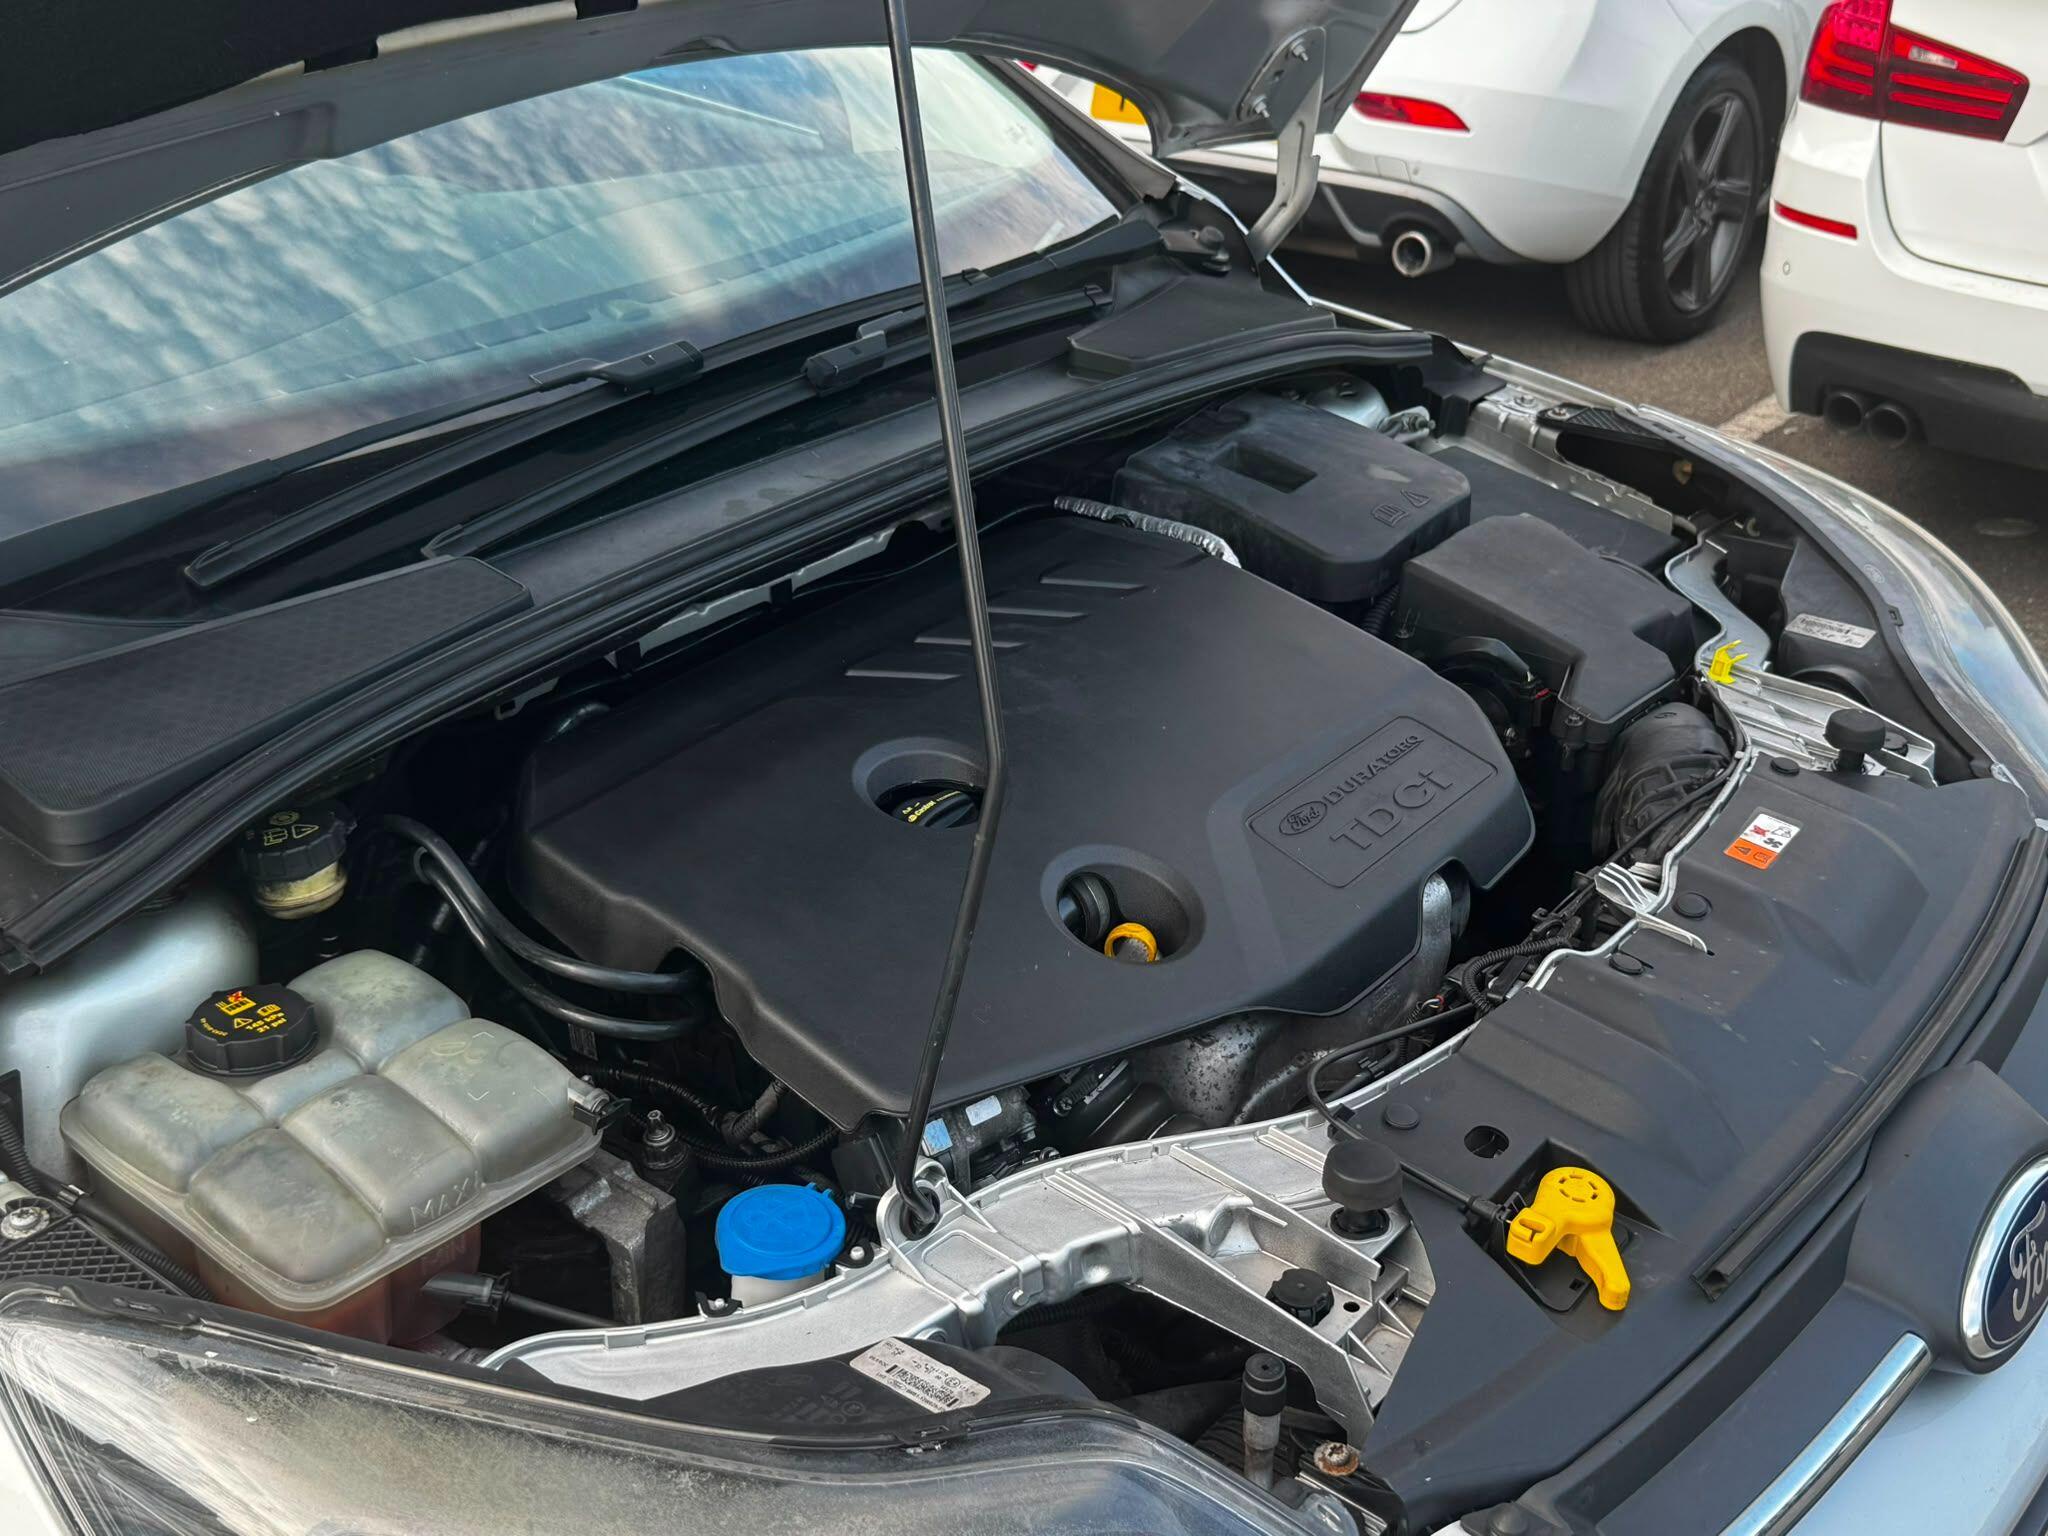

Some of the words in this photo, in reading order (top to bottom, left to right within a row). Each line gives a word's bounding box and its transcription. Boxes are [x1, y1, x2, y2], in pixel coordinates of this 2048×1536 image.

[1286, 806, 1320, 832] Ford
[1323, 735, 1425, 806] DURATORQ
[256, 1025, 270, 1033] 21
